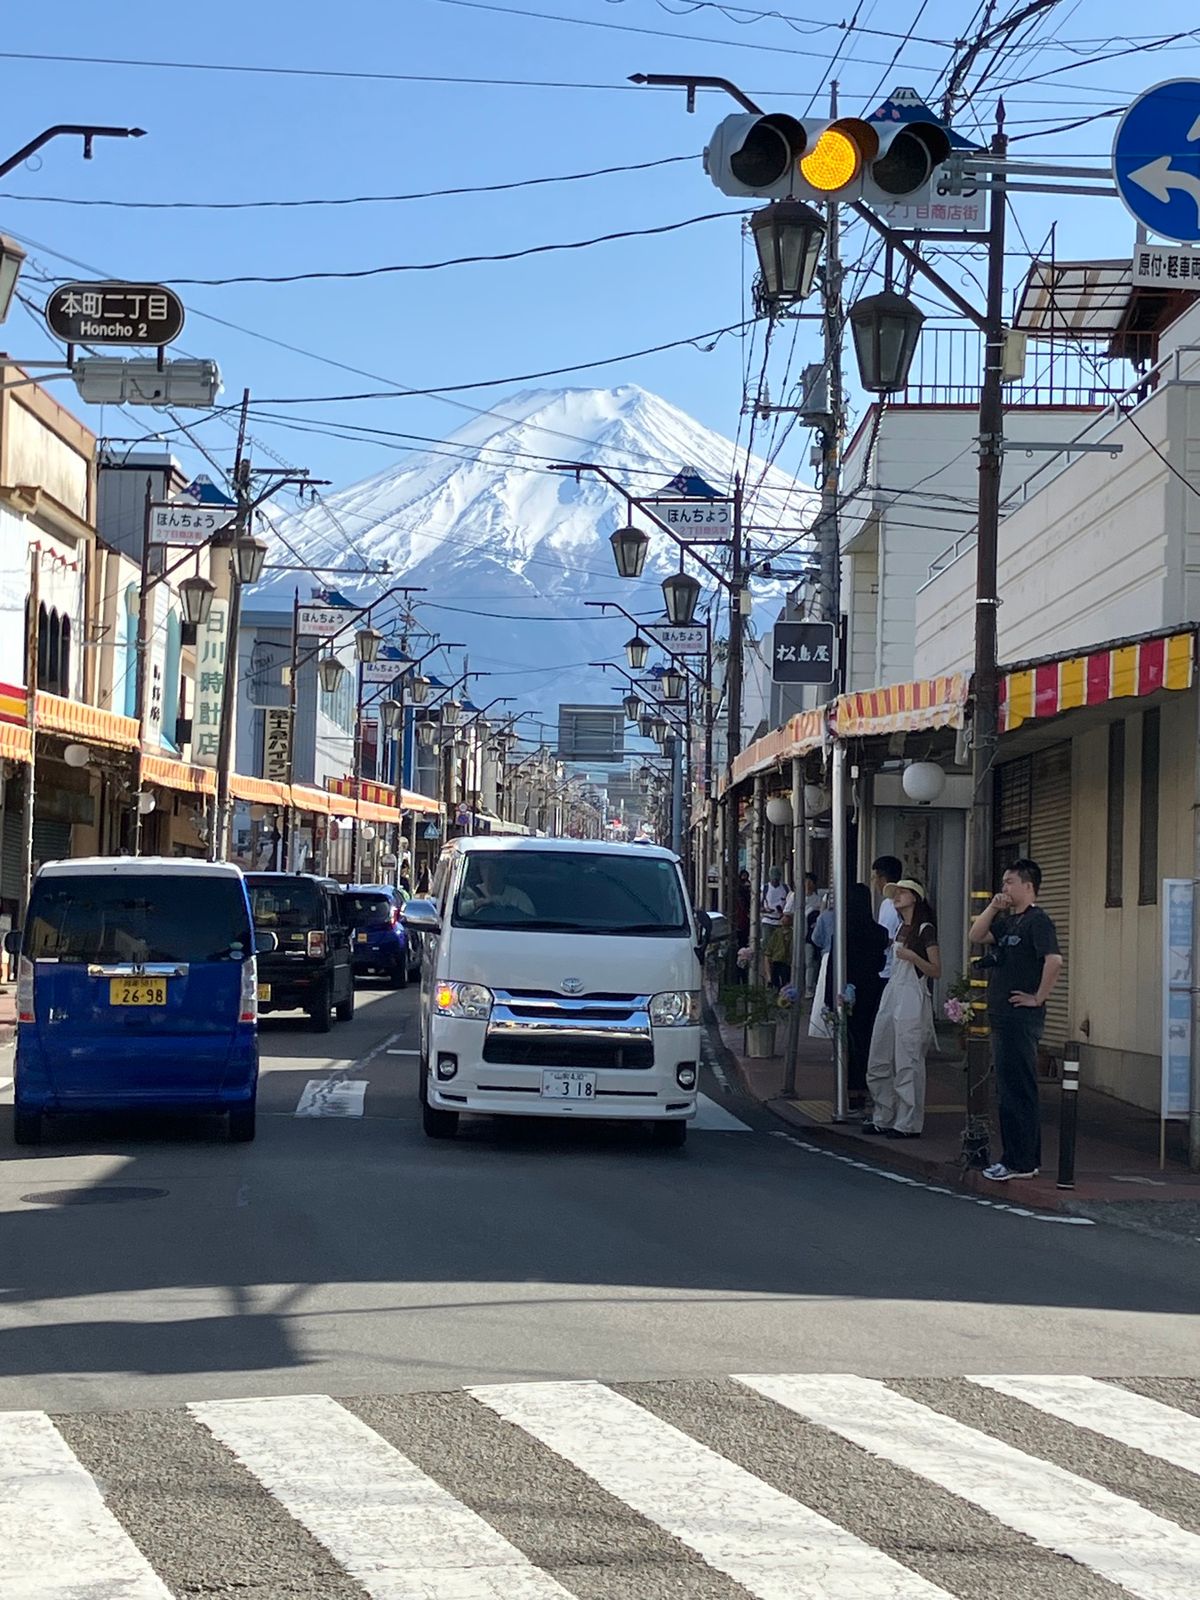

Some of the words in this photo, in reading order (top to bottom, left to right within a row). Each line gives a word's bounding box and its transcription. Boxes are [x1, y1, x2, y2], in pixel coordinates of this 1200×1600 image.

[60, 292, 168, 320] 本町二丁目
[80, 321, 133, 337] Honcho
[137, 323, 148, 337] 2
[156, 512, 216, 529] ほんちょう
[667, 508, 729, 523] ほんちょう
[301, 612, 345, 624] ほんちょう
[662, 631, 703, 642] ほんちょう
[776, 644, 830, 662] 松島屋
